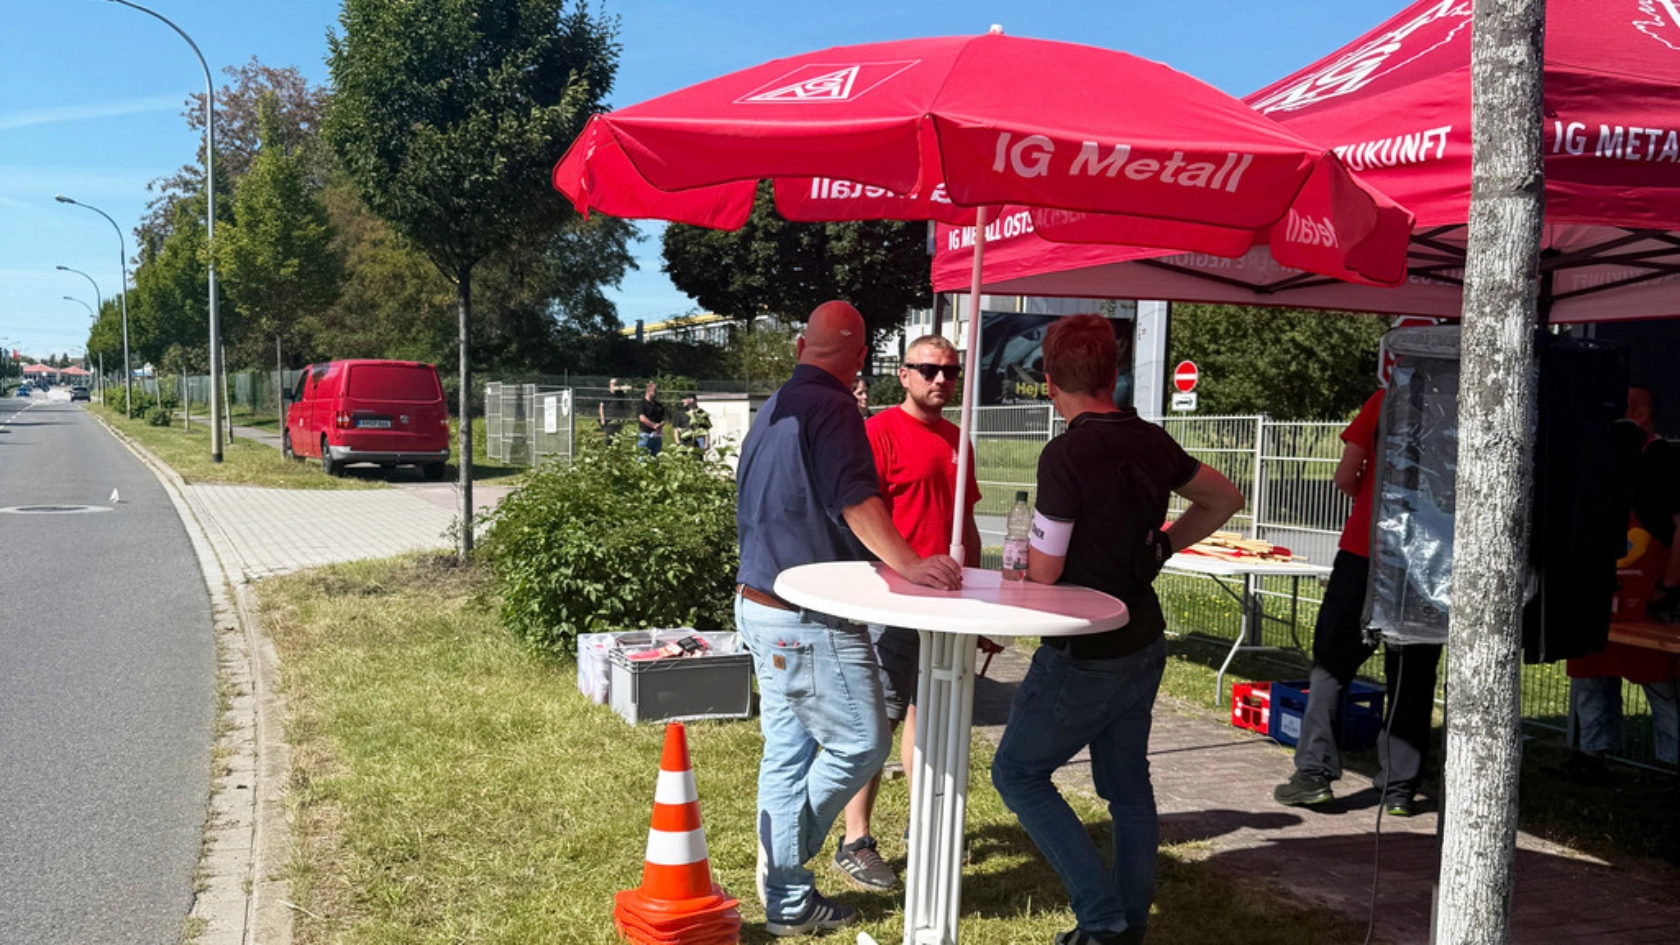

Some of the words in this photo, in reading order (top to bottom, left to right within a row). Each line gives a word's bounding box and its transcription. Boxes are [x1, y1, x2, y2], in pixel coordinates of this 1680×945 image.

[992, 132, 1055, 178] IG
[1069, 140, 1254, 193] Metall
[1333, 125, 1452, 171] ZUKUNFT
[1552, 121, 1587, 155] IG
[1595, 124, 1680, 163] META
[948, 229, 960, 250] IG
[961, 219, 1001, 248] MEALL
[1015, 381, 1038, 397] Hej
